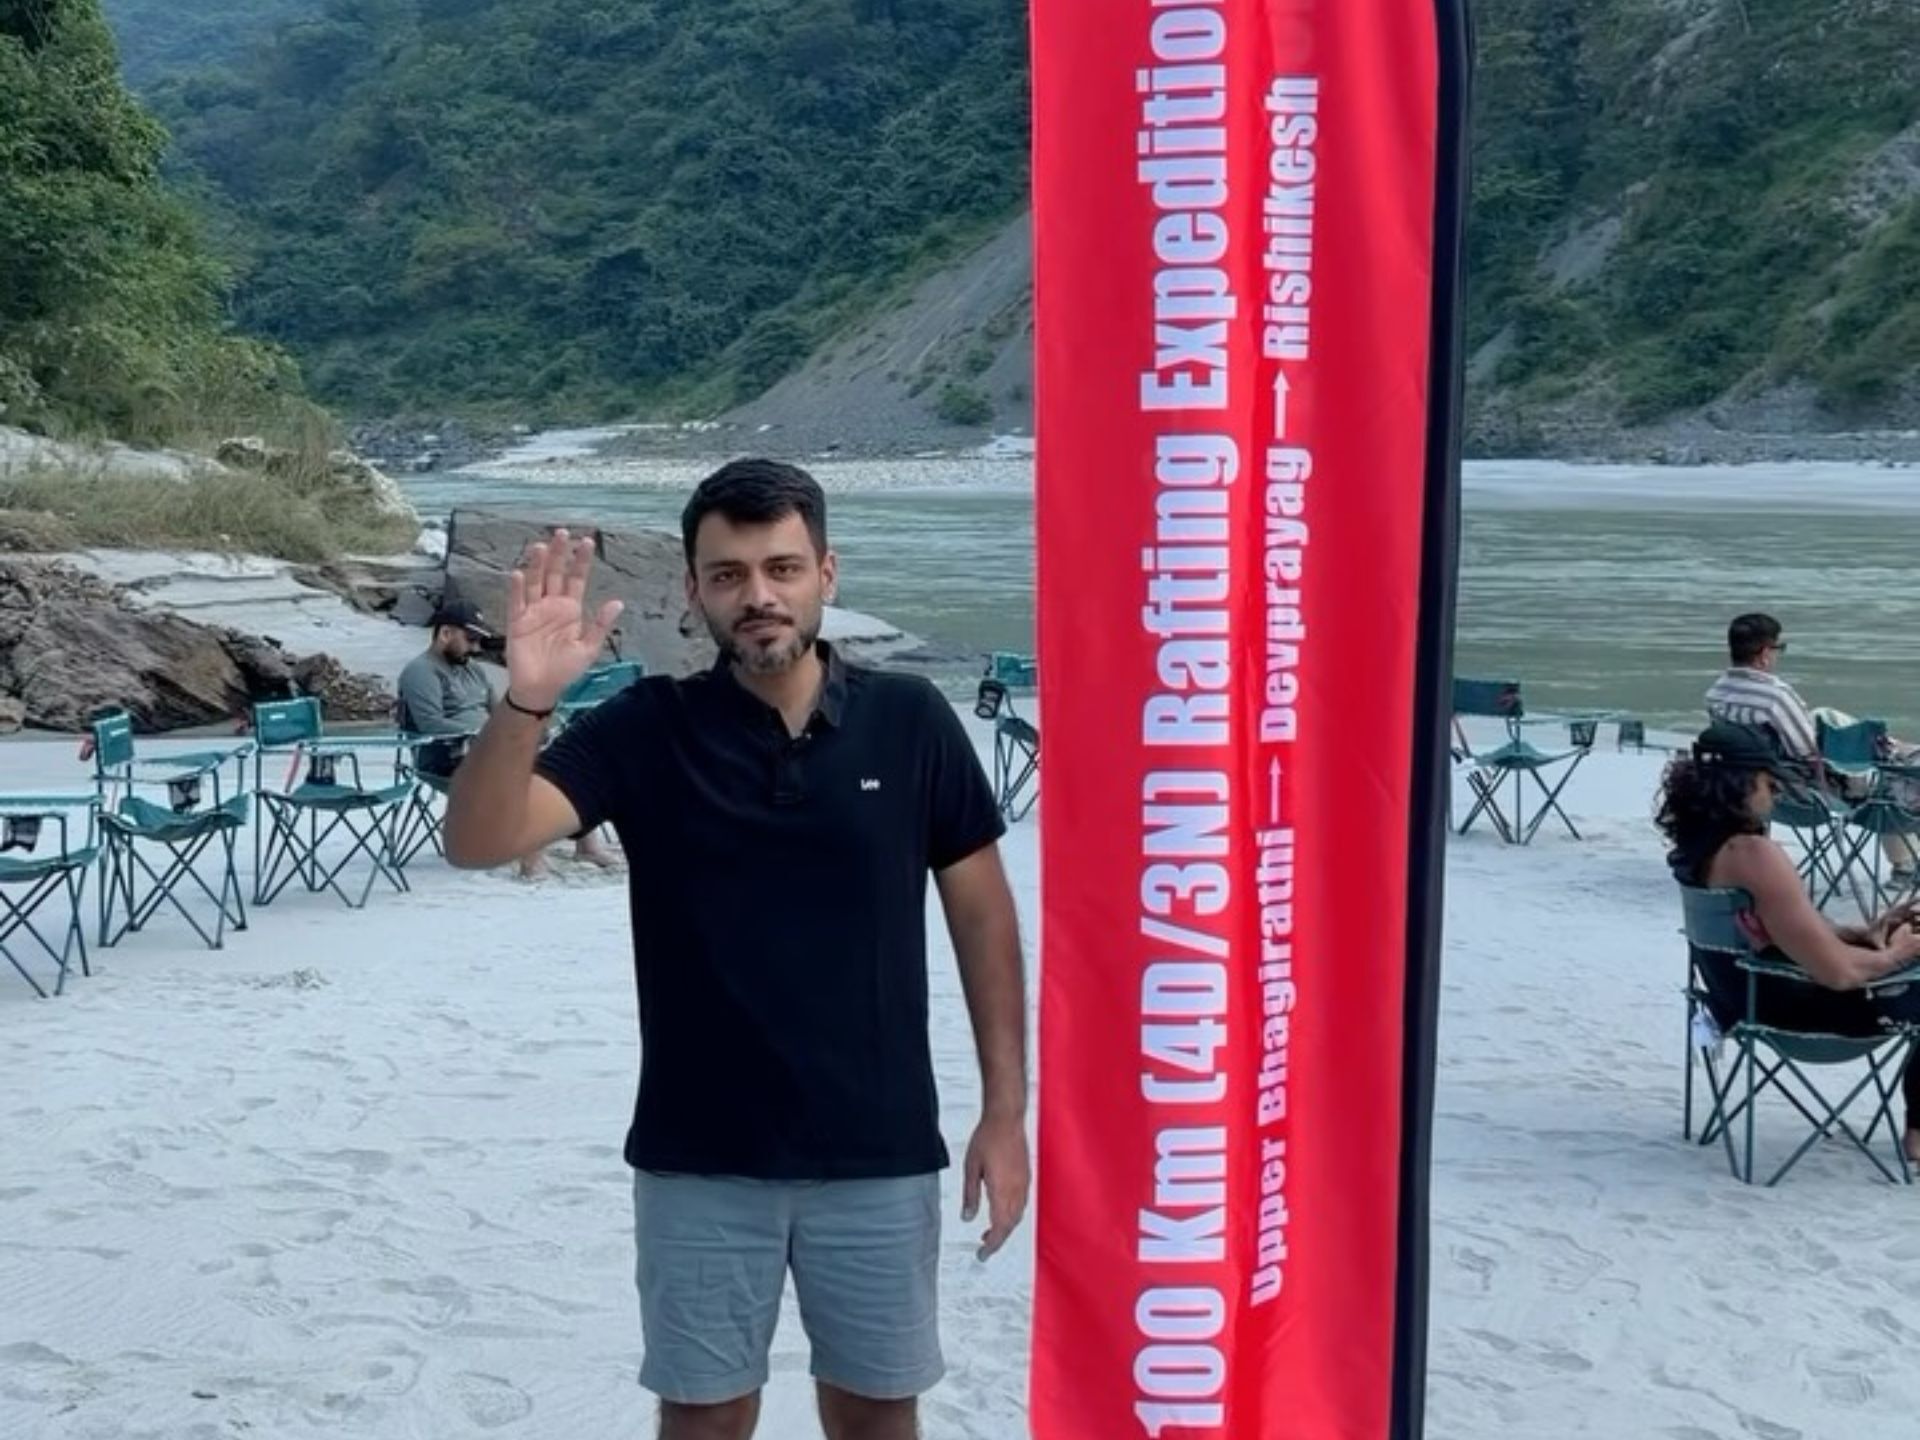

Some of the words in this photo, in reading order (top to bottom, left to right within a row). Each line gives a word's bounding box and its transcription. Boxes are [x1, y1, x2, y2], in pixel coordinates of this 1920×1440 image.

[1136, 0, 1238, 410] Expeditio
[1262, 76, 1319, 360] Rishikesh
[1141, 434, 1240, 745] Rafting
[1260, 447, 1313, 743] Devprayag
[1140, 771, 1230, 1103] (4D/3N)
[1256, 827, 1297, 1127] Bhagirathi
[1137, 1127, 1227, 1263] Km
[1250, 1139, 1289, 1308] Upper
[1133, 1287, 1227, 1439] 100
